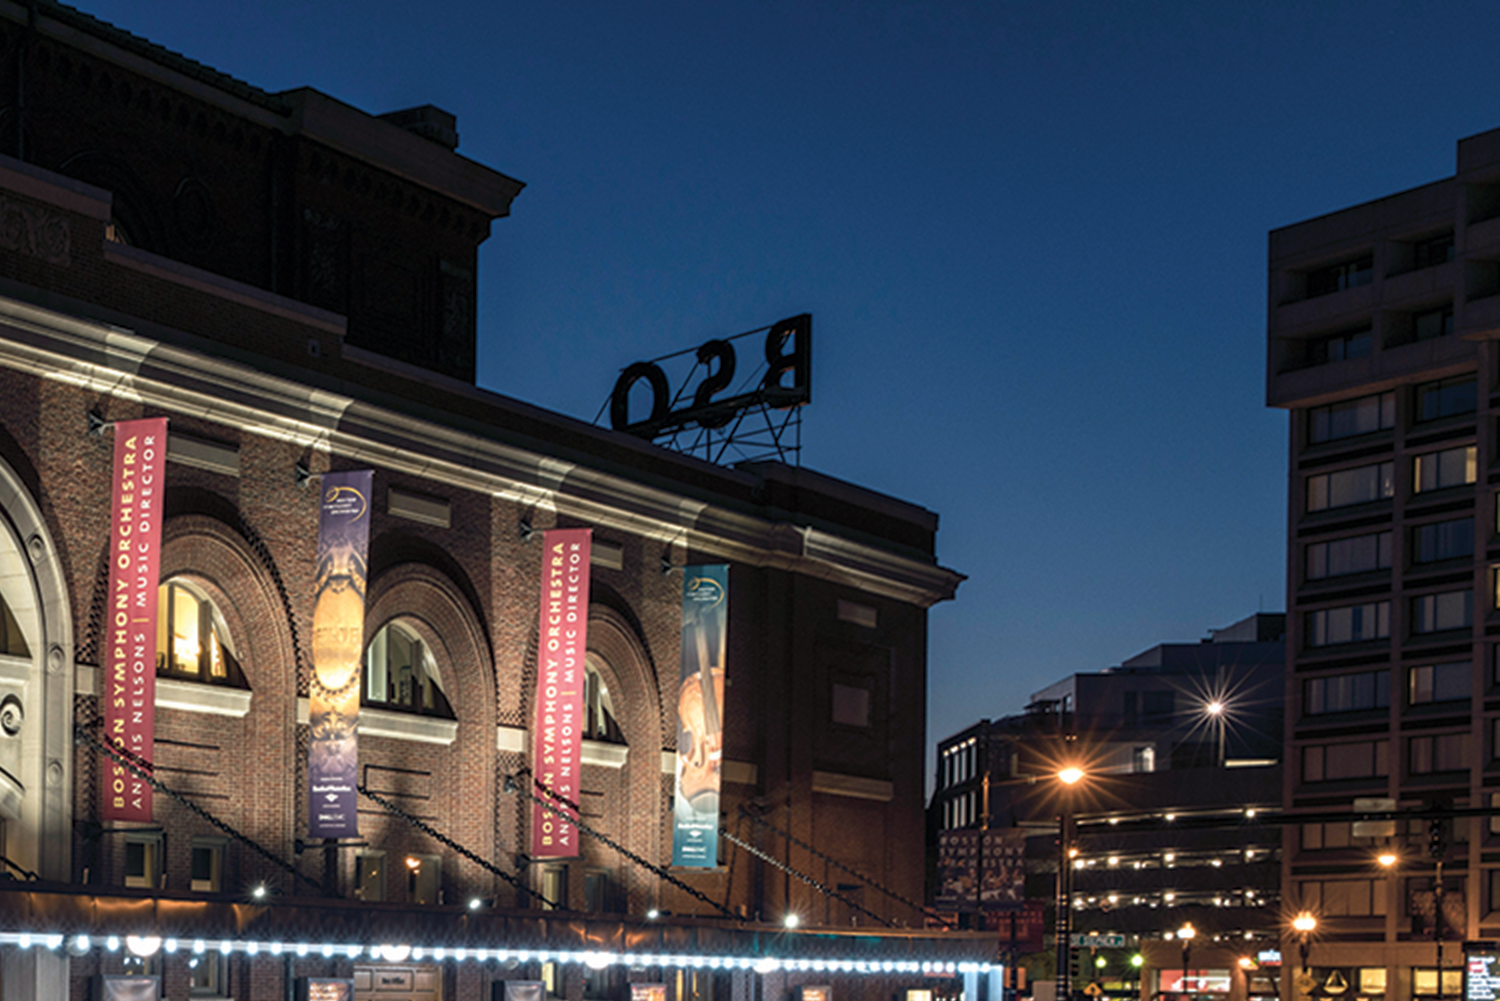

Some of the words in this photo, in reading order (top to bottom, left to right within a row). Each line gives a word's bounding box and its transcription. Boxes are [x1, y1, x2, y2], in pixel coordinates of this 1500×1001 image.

[117, 435, 138, 570] ORCHESTRA
[139, 435, 156, 534] DIRECTOR
[136, 542, 150, 608] MUSIC
[547, 541, 565, 652] ORCHESTRA
[566, 542, 581, 623] DIRECTOR
[113, 579, 130, 709] SYMPHONY
[132, 632, 146, 724] NELSONS
[564, 629, 577, 684] MUSIC
[543, 658, 559, 765] SYMPHONY
[560, 702, 574, 777] NELSONS
[112, 718, 125, 809] BOSON
[542, 772, 555, 846] BOSON
